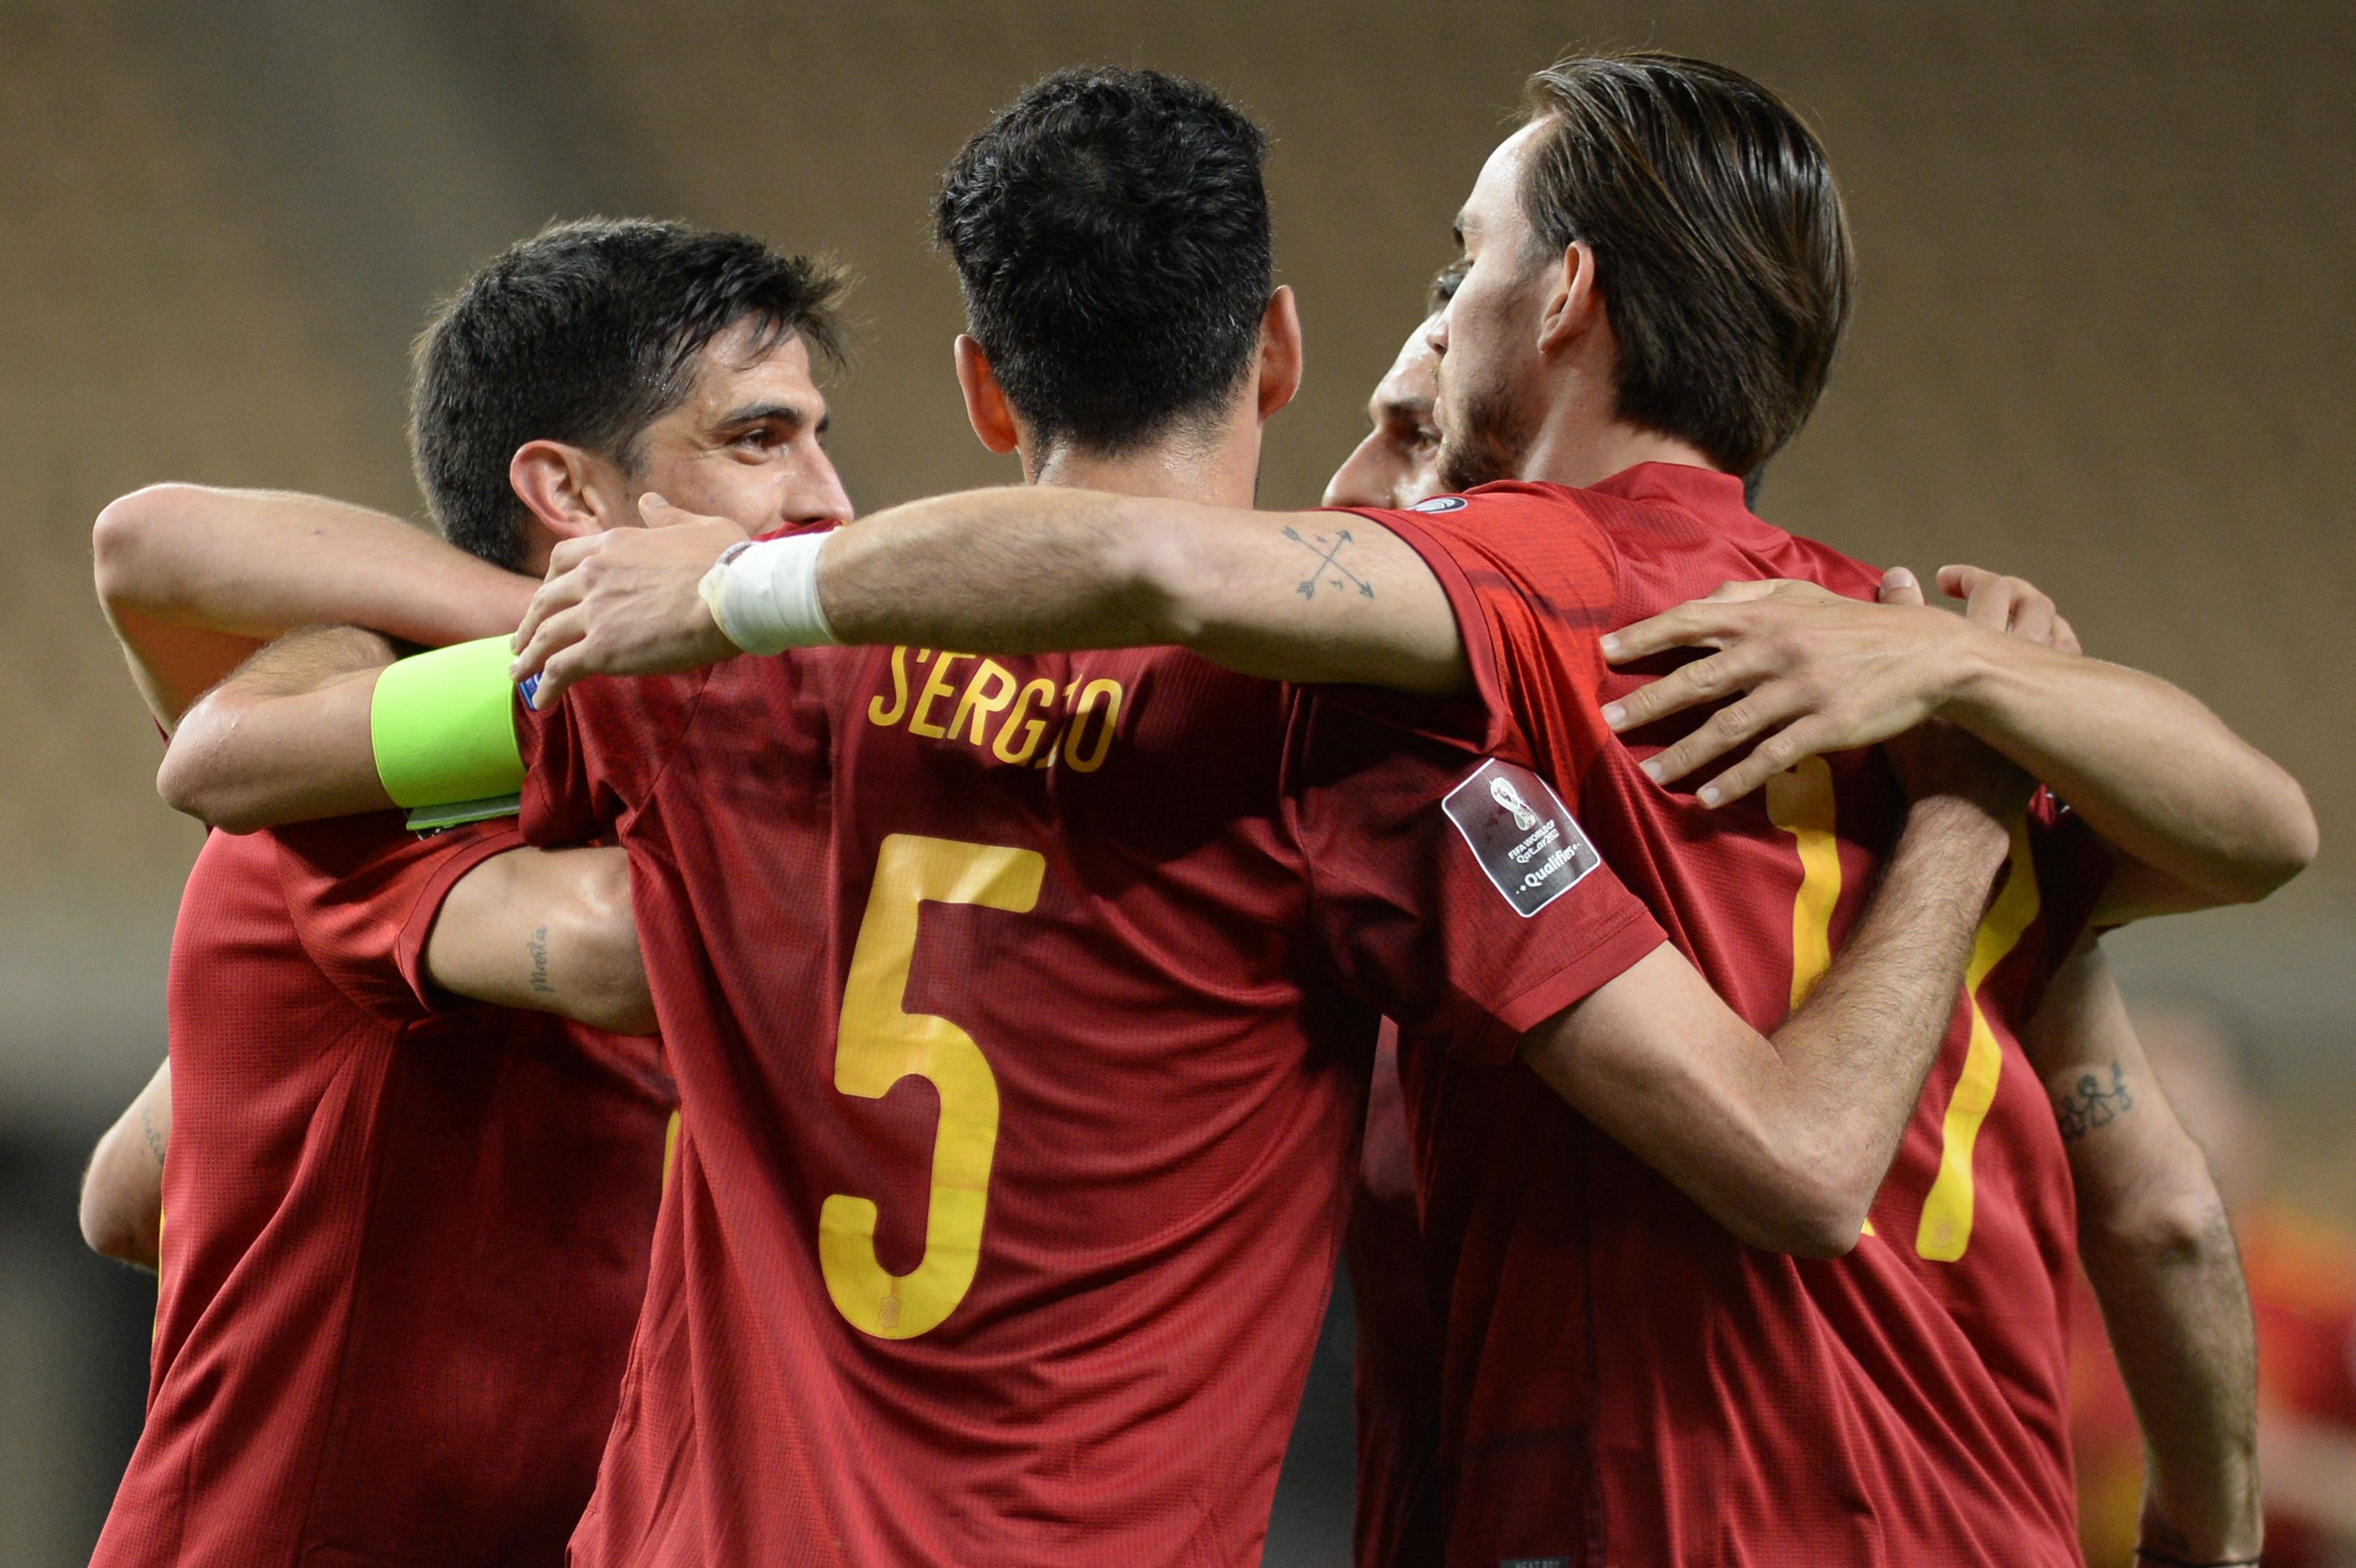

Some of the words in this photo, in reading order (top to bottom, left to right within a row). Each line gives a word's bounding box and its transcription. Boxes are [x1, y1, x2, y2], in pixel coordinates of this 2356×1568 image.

[1507, 844, 1527, 860] FIFA
[1523, 825, 1550, 847] WORLD
[819, 833, 1046, 1340] 5
